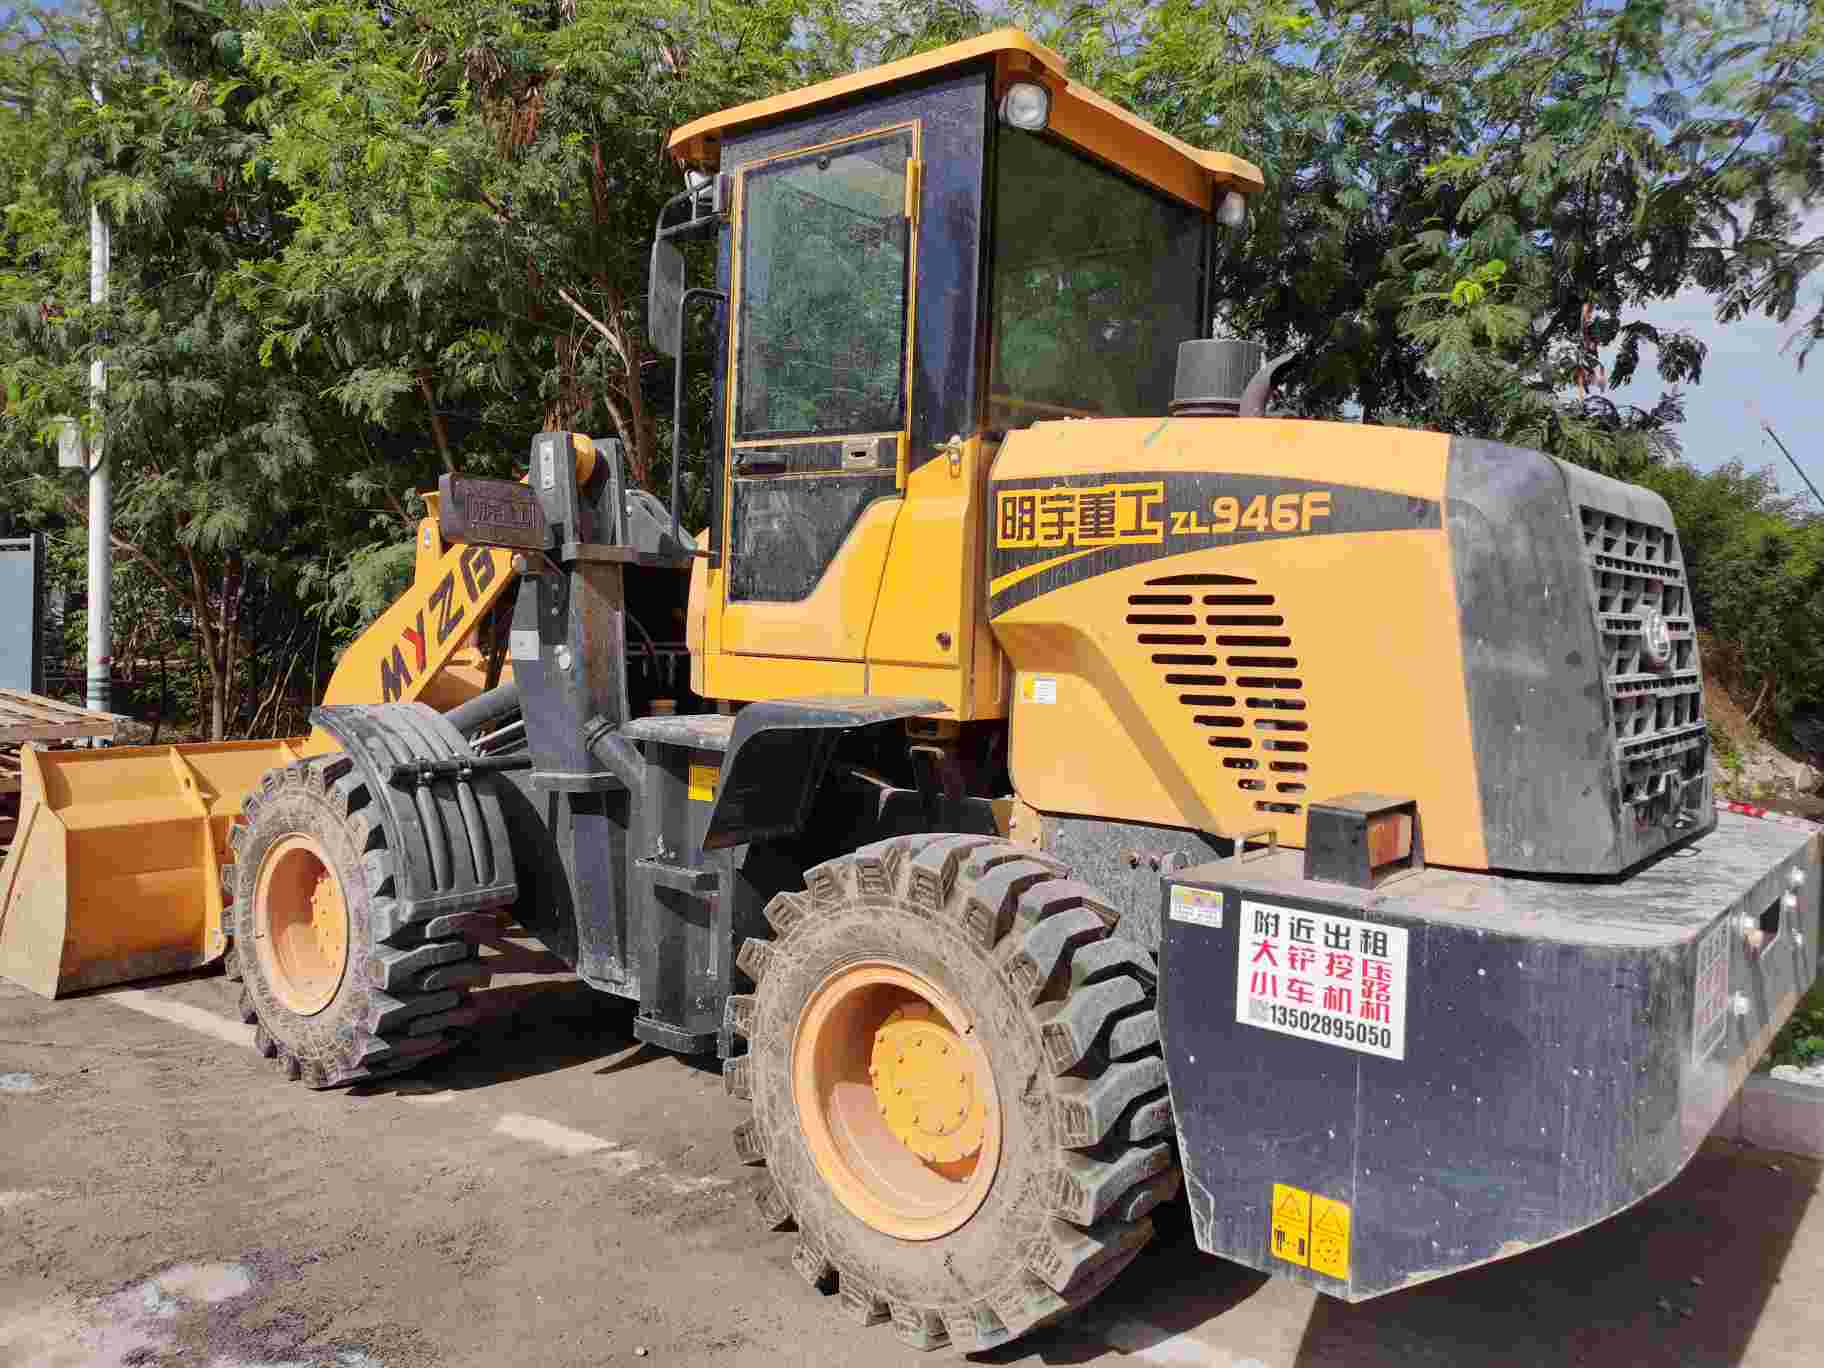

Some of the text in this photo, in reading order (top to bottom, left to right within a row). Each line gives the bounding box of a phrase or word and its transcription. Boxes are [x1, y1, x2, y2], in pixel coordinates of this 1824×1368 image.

[999, 485, 1161, 545] 明宇重工
[1254, 909, 1389, 958] 附近出租
[1270, 1003, 1392, 1050] 13502895050
